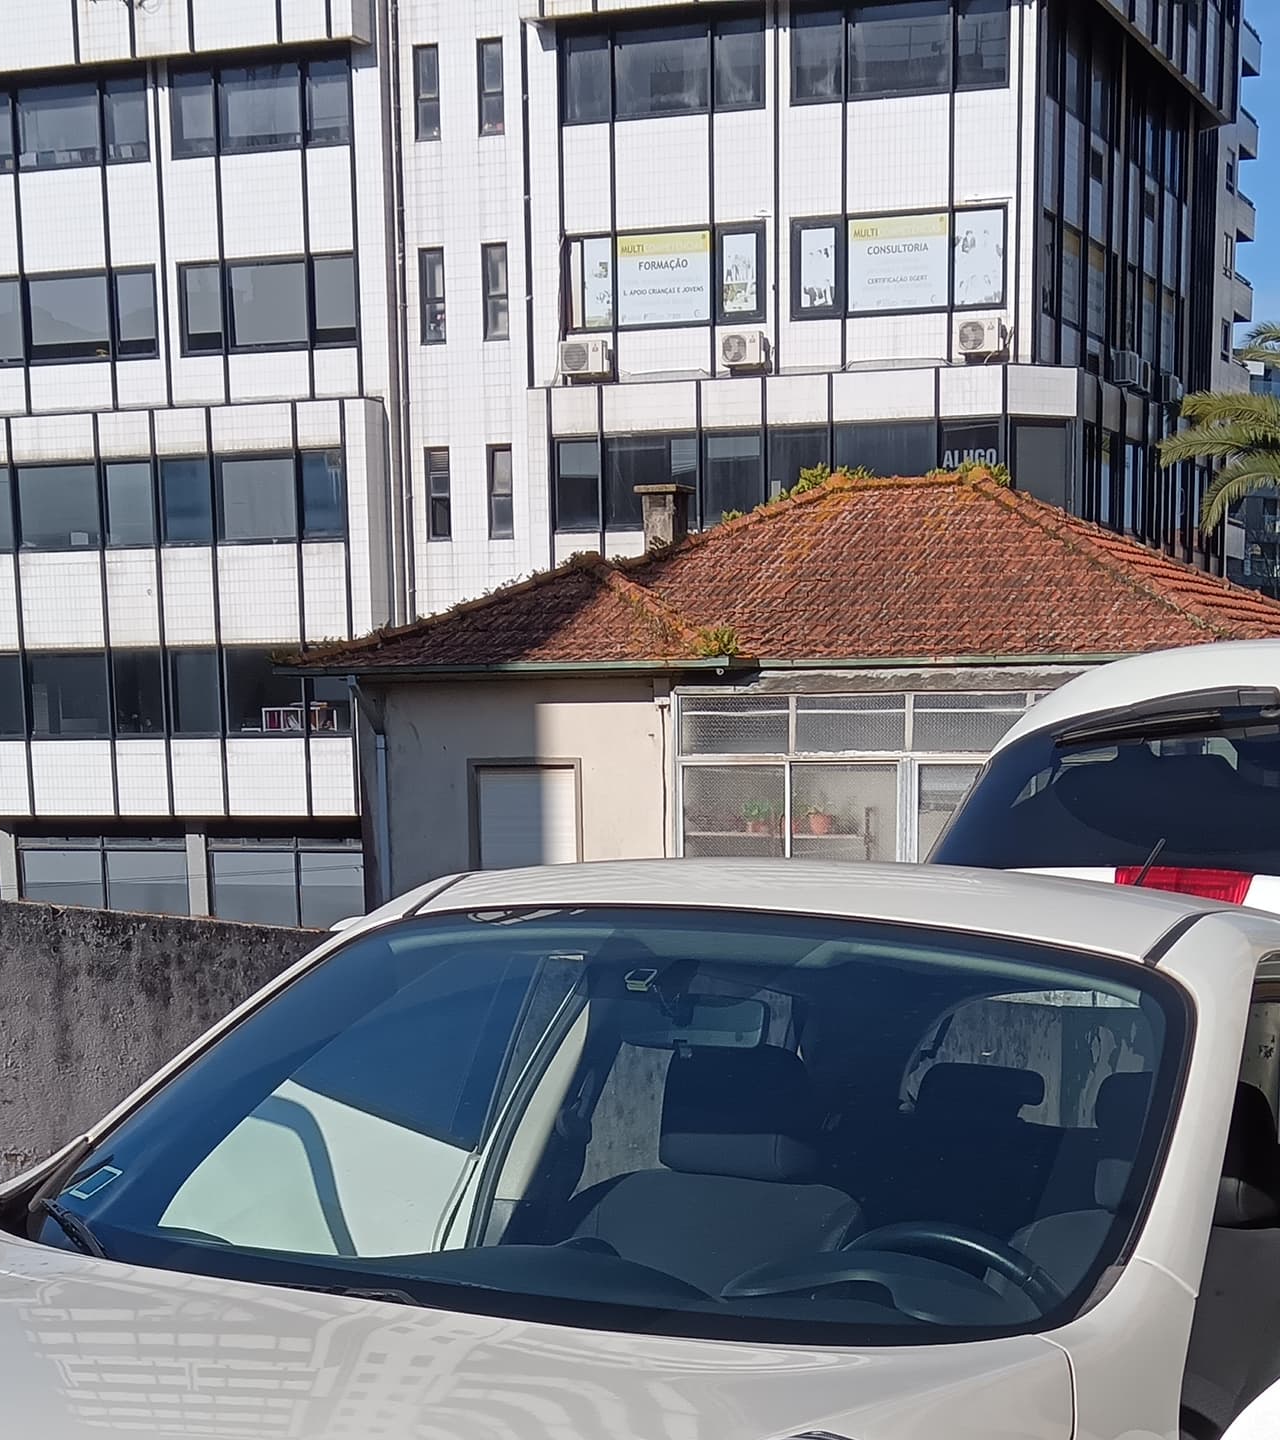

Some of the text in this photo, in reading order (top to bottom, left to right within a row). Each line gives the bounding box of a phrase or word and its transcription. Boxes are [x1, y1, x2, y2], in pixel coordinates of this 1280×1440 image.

[867, 242, 928, 255] CONSULTORIA
[638, 257, 688, 271] FORMAÇÃO
[630, 288, 647, 296] APOIO
